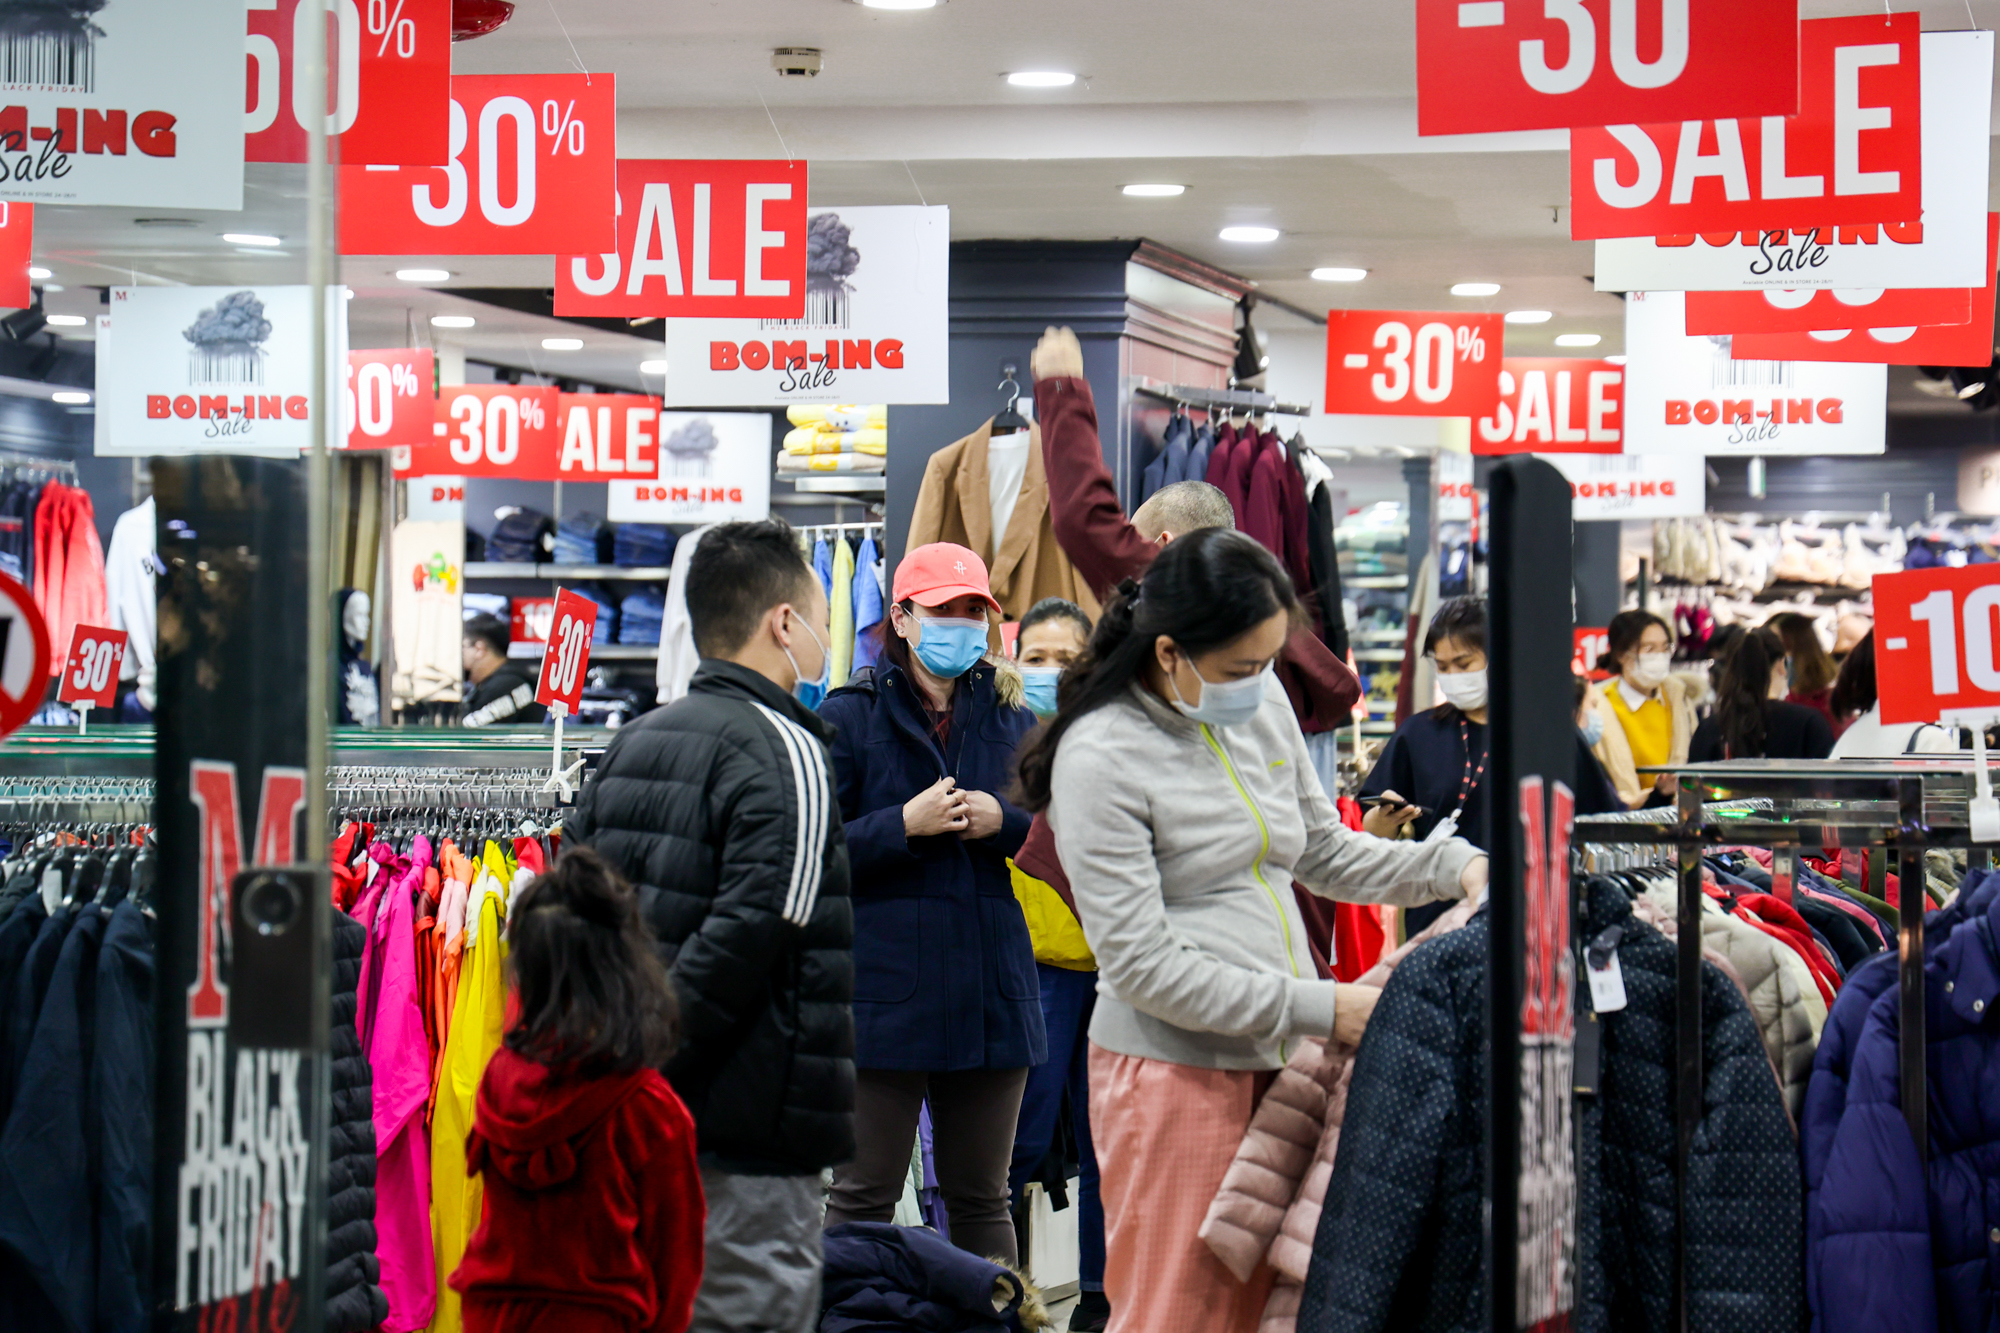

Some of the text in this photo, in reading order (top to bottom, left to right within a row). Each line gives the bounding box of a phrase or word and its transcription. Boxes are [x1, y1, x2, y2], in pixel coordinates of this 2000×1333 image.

[40, 85, 84, 93] FRIDAY
[1594, 43, 1899, 209] SALE
[366, 95, 585, 226] 30%
[1750, 227, 1829, 275] Sale
[710, 338, 904, 371] BOM-ING
[779, 353, 837, 392] Sale
[1344, 321, 1485, 403] -30%
[147, 394, 308, 419] BOM-ING
[205, 406, 252, 438] Sale
[433, 394, 545, 465] -30%
[556, 406, 656, 473] ALE
[1479, 370, 1622, 444] SALE
[1665, 398, 1843, 425] BOM-ING
[1728, 411, 1781, 444] Sale
[69, 638, 122, 692] -30%
[549, 614, 592, 696] -30%
[1886, 584, 2000, 695] -10
[185, 1030, 304, 1167] BLACK
[176, 1141, 309, 1313] FRIDAY
